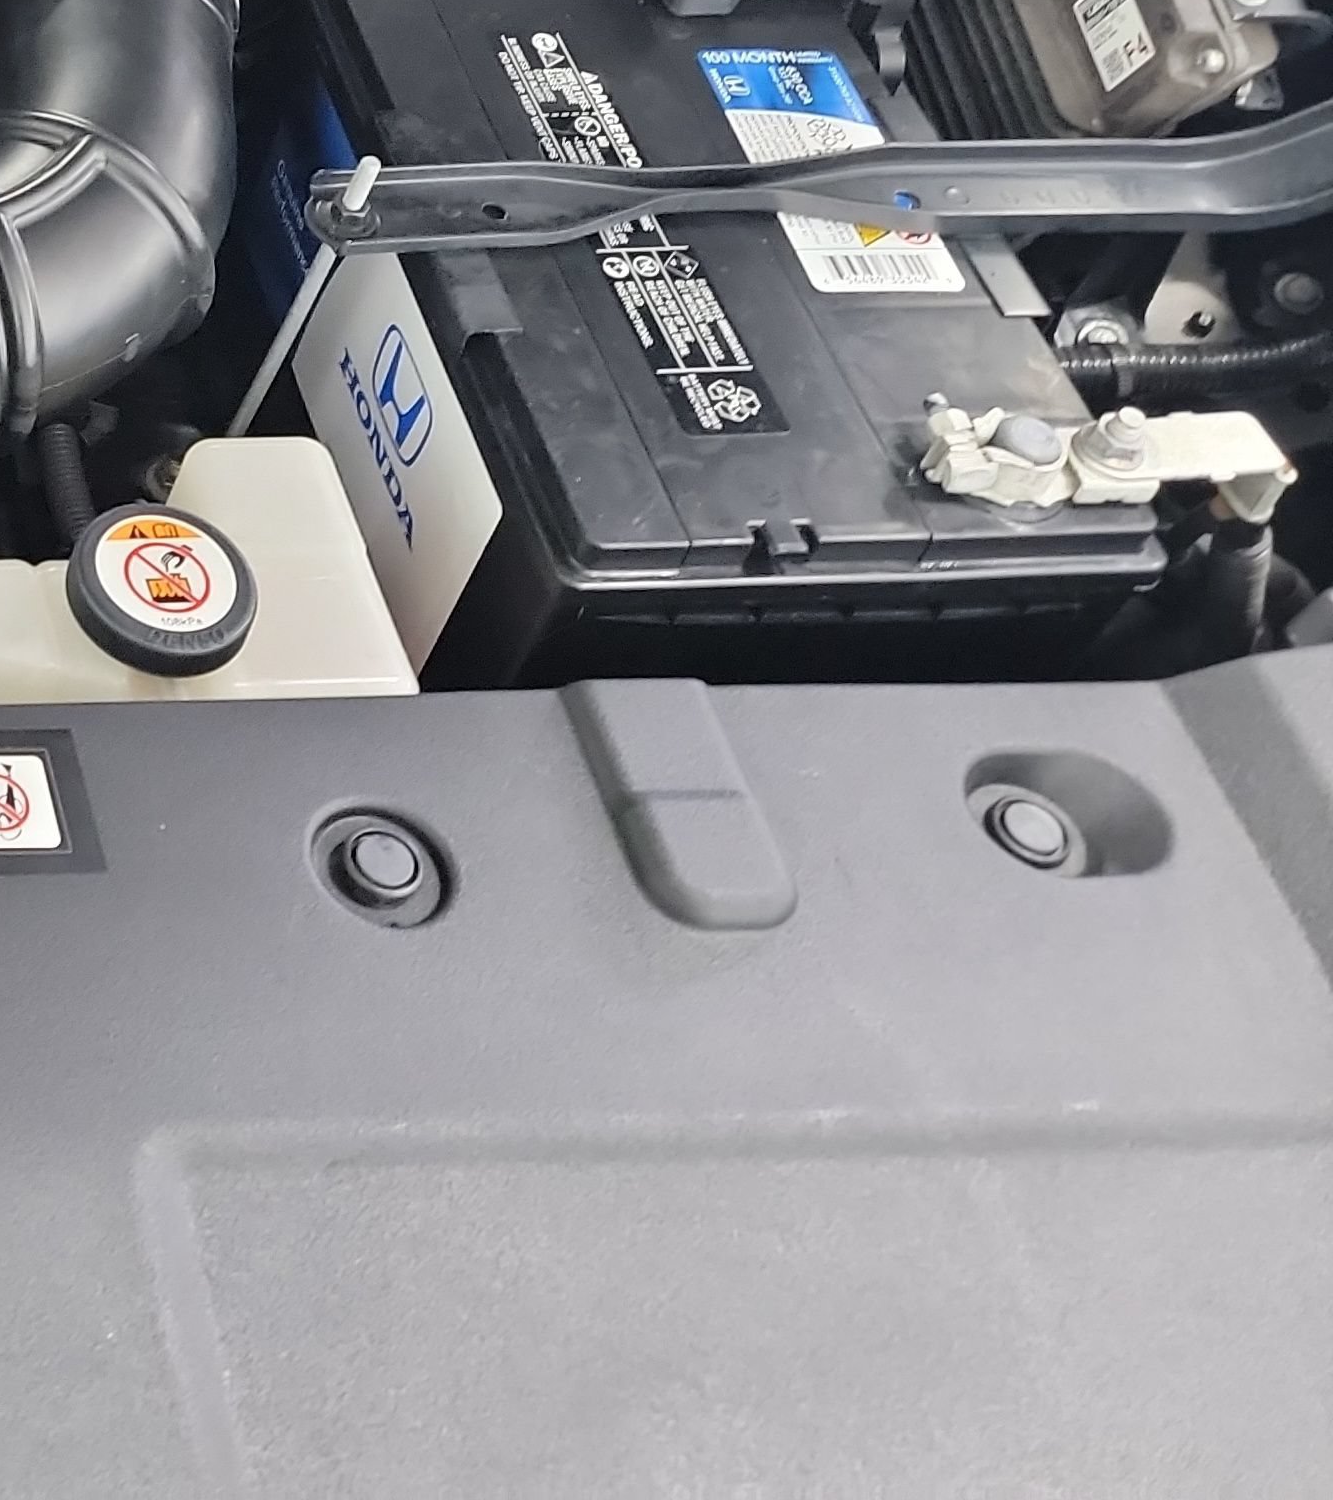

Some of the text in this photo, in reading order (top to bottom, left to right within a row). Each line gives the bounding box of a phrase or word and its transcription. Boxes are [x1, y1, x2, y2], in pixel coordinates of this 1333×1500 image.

[702, 51, 730, 64] 100
[732, 51, 797, 64] MONTH
[339, 347, 413, 553] HONDA
